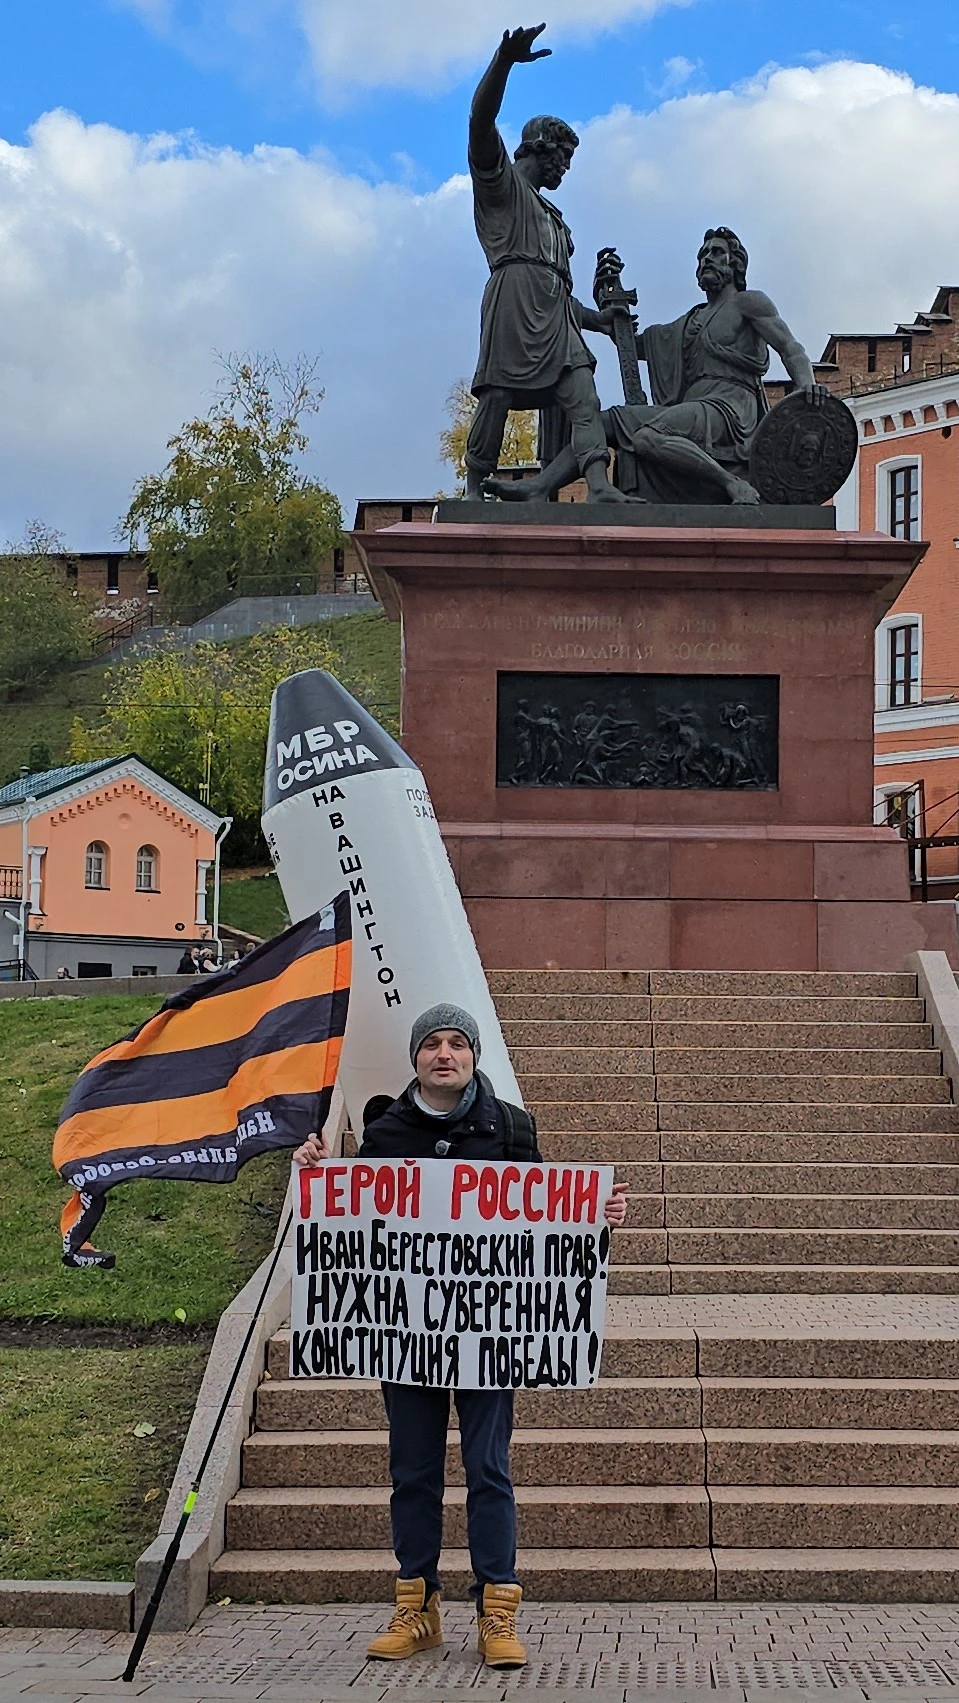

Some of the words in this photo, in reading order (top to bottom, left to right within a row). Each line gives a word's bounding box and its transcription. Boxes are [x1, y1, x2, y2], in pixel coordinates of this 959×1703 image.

[276, 720, 361, 768] МБР
[277, 745, 380, 791] ОСИНА
[312, 785, 346, 808] НА
[328, 812, 402, 1008] ВАШИНГТОН
[299, 1159, 421, 1219] ГЕРОЙ
[451, 1164, 600, 1224] РОССИИ
[545, 1225, 610, 1280] ПРАВ!
[306, 1273, 409, 1326] НУЖНА
[423, 1278, 593, 1334] СУВЕРЕННАЯ
[292, 1326, 460, 1388] КОНСТИТУЦИЯ
